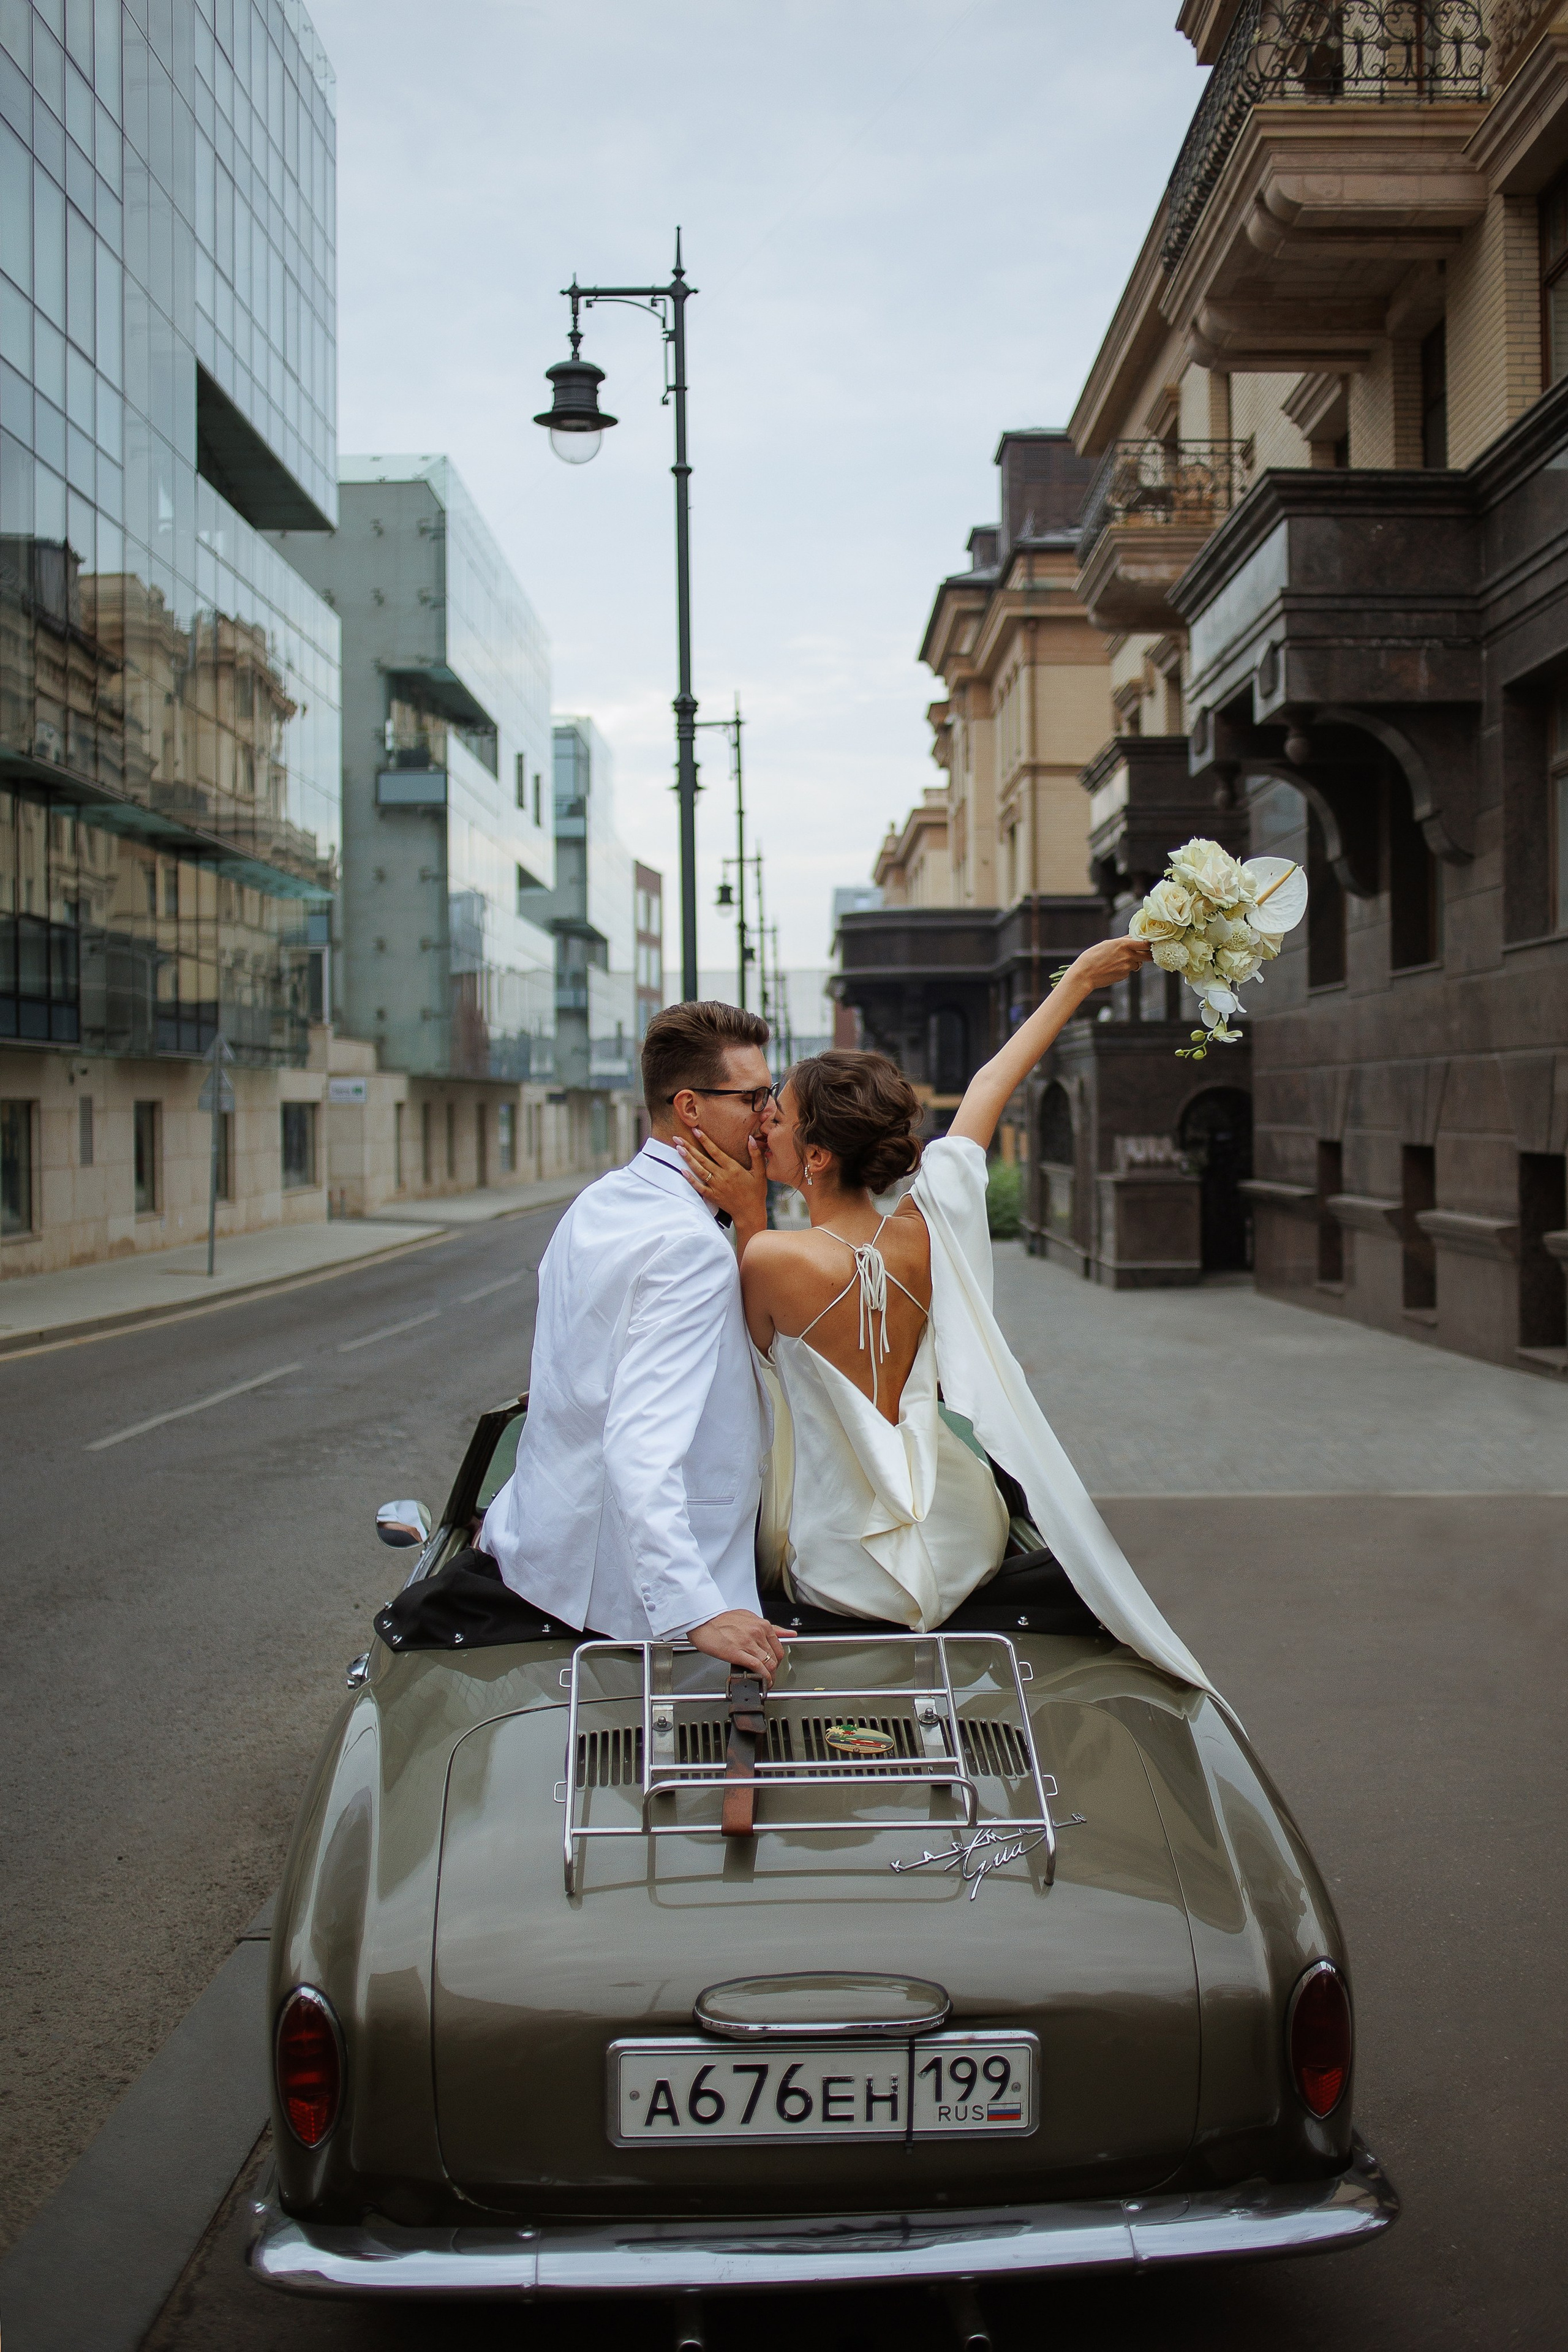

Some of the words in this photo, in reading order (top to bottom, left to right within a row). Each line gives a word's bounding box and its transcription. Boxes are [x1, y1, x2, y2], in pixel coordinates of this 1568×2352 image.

[890, 1812, 1087, 1872] KARMAN
[919, 2054, 1011, 2101] 199
[938, 2105, 984, 2122] RUS
